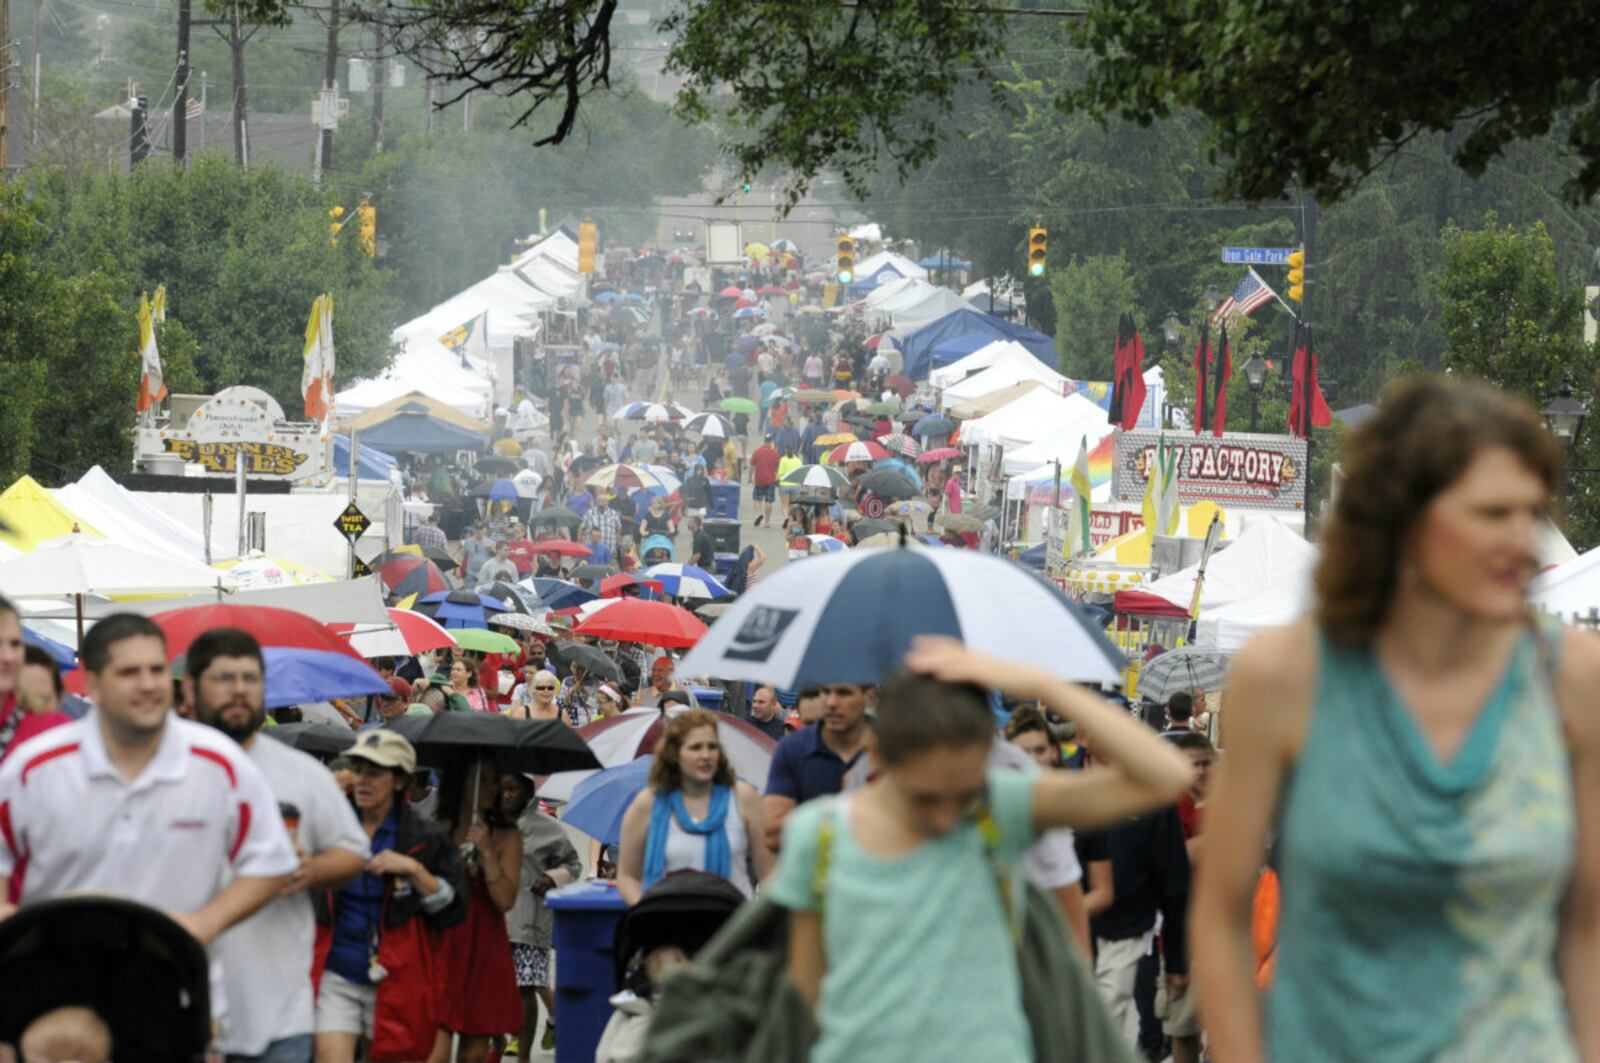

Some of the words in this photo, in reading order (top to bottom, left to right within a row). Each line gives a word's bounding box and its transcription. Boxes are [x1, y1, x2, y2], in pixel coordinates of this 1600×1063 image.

[163, 439, 309, 465] FUNNEL
[199, 454, 297, 474] AKES
[1143, 445, 1184, 479] FY
[1189, 445, 1283, 484] FACTORY
